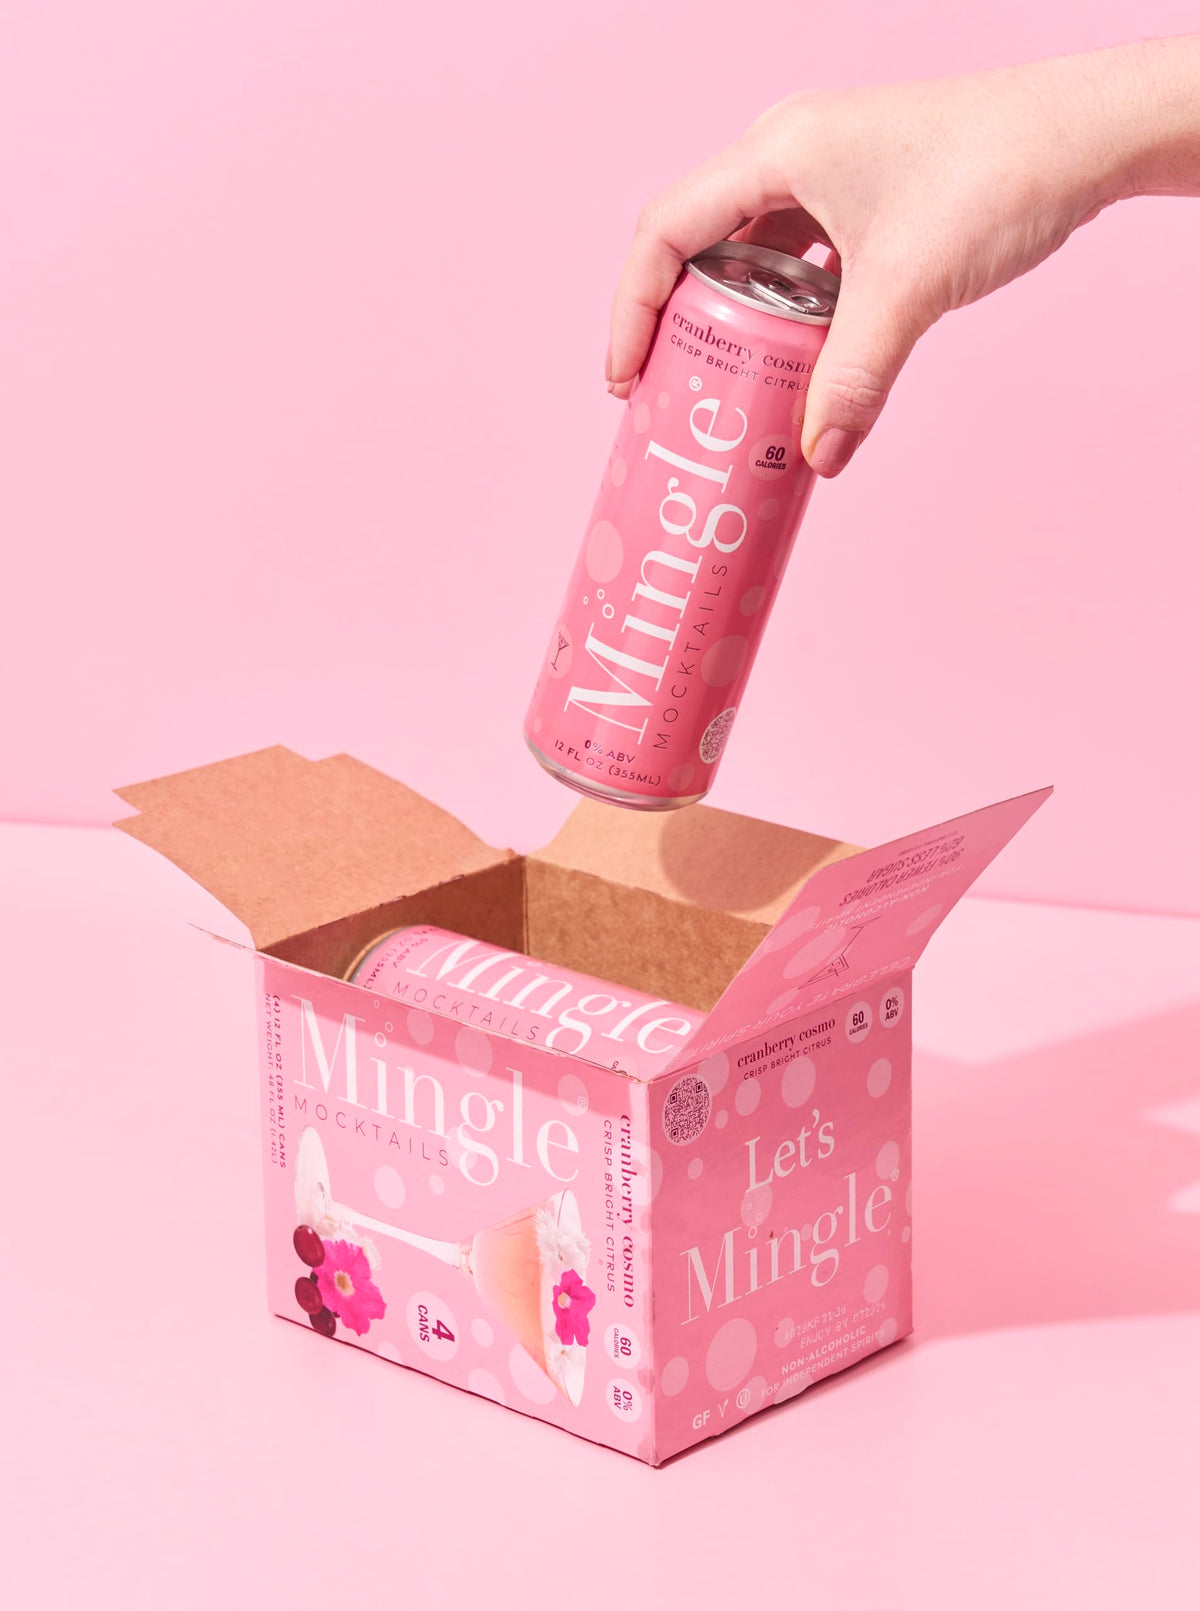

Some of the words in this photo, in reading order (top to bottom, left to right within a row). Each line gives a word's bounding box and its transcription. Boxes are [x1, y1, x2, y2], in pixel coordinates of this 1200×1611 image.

[670, 335, 702, 358] CRISP
[706, 354, 759, 381] BRIGHT
[672, 311, 756, 365] cranberry
[762, 353, 814, 375] cosm
[755, 459, 786, 470] CALORIES
[765, 446, 785, 462] 60
[653, 563, 728, 750] MOCKTAILS
[554, 739, 563, 751] 12
[567, 747, 581, 761] FL
[585, 757, 604, 771] OZ
[608, 765, 661, 786] (355ML)
[584, 739, 603, 755] 0%
[606, 751, 635, 764] ABV
[866, 857, 910, 883] SUGAR
[895, 857, 939, 884] FEWER
[906, 845, 940, 867] LESS
[839, 874, 900, 907] CALORIES
[405, 939, 692, 1056] Mingle
[807, 956, 911, 1008] CELEBRATE
[264, 993, 272, 1015] NET
[392, 981, 540, 1041] MOCKTAILS
[753, 1002, 802, 1031] YOUR
[852, 1011, 865, 1027] 60
[885, 995, 899, 1011] 0%
[885, 1008, 899, 1021] ABV
[275, 1033, 282, 1047] FL
[737, 1032, 796, 1068] cranberry
[799, 1018, 836, 1042] cosmo
[849, 1023, 868, 1036] CALORIES
[275, 1053, 283, 1070] OZ
[743, 1064, 768, 1081] CRISP
[771, 1050, 801, 1070] BRIGHT
[803, 1036, 832, 1056] CITRUS
[294, 1095, 449, 1167] MOCKTAILS
[603, 1119, 612, 1168] CRISP
[278, 1133, 287, 1169] CANS
[744, 1108, 835, 1194] Let's
[617, 1114, 638, 1231] cranberry
[604, 1172, 614, 1229] BRIGHT
[606, 1236, 615, 1292] CITRUS
[622, 1235, 635, 1308] cosmo
[417, 1304, 430, 1343] CANS
[431, 1319, 455, 1343] 4
[800, 1326, 831, 1349] ENJOY
[836, 1318, 849, 1332] BY
[619, 1337, 632, 1357] 60
[782, 1325, 866, 1375] NON-ALCOHOLIC
[761, 1382, 780, 1398] FOR
[783, 1348, 848, 1388] INDEPENDENT
[851, 1330, 885, 1352] SPIRITS
[613, 1385, 622, 1409] ABV
[622, 1391, 633, 1411] 0%
[692, 1409, 711, 1430] GF
